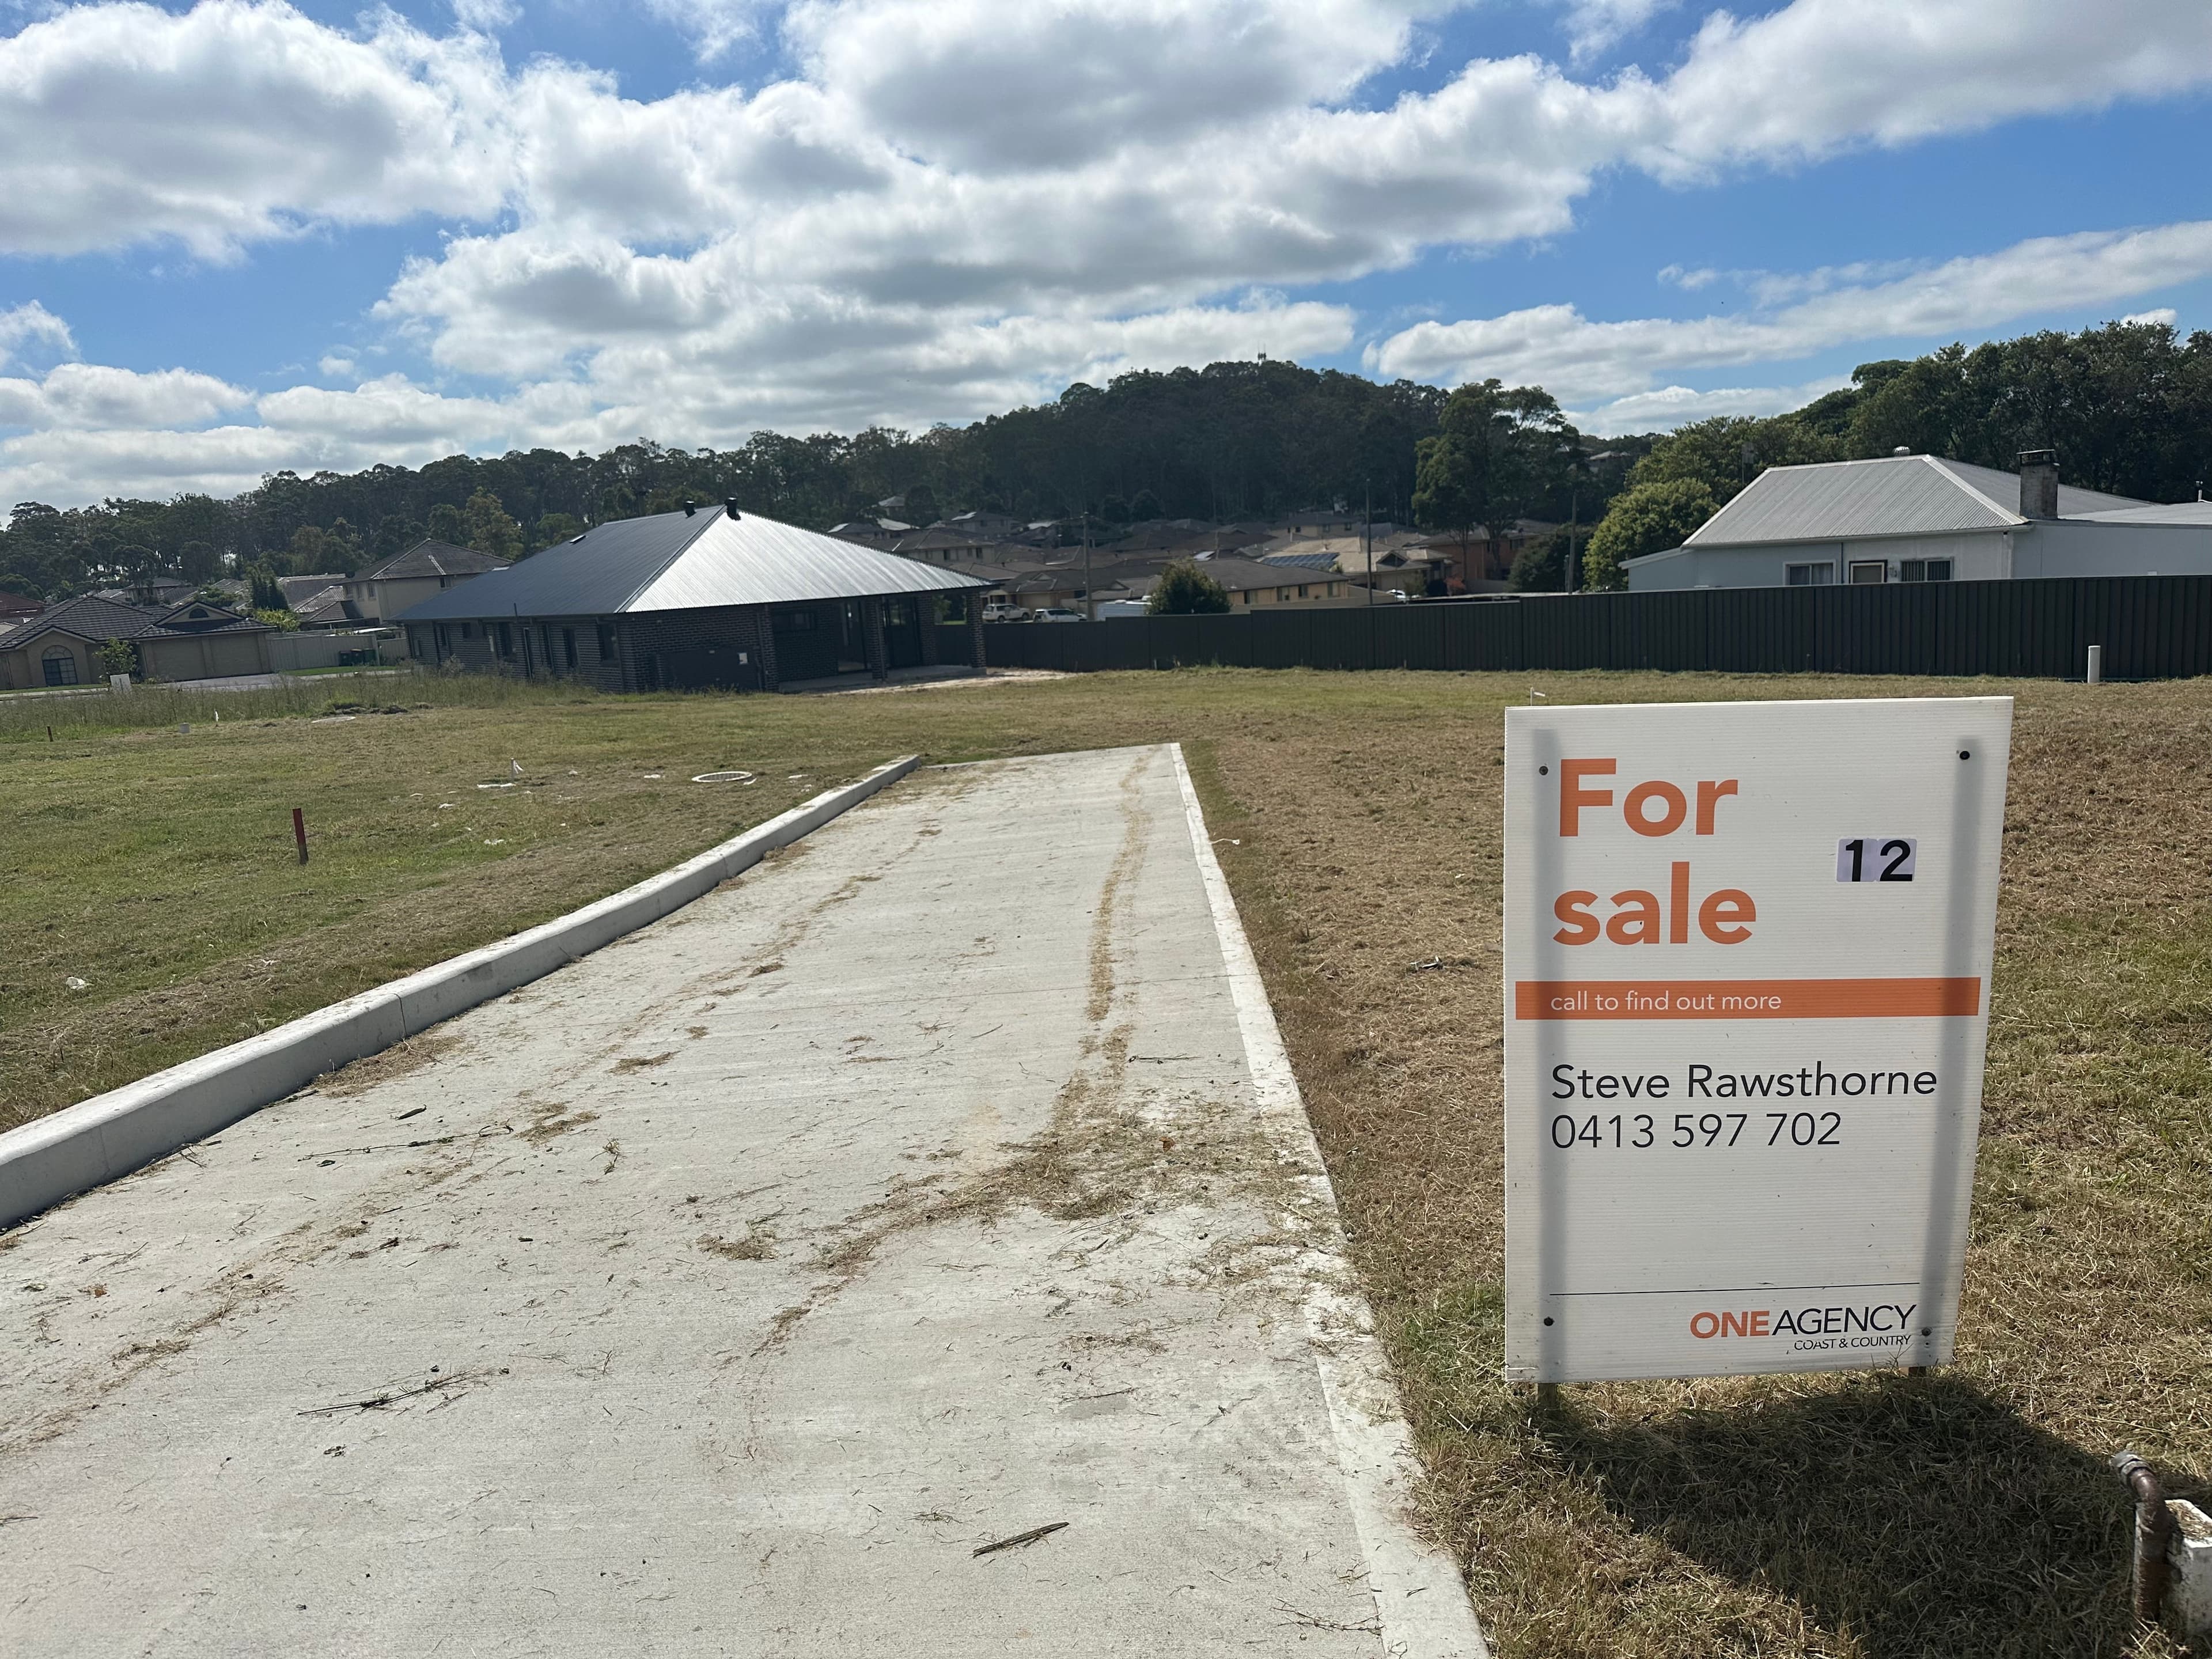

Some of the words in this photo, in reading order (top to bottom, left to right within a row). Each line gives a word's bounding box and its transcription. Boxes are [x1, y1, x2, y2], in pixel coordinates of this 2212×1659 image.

[1559, 758, 1738, 837] For
[1845, 839, 1913, 882] 12
[1553, 861, 1756, 945] sale
[1551, 990, 1588, 1011] call
[1594, 994, 1619, 1011] to
[1625, 990, 1669, 1010] find
[1676, 994, 1715, 1010] out
[1721, 995, 1782, 1010] more
[1551, 1064, 1670, 1099] Steve
[1688, 1060, 1937, 1099] Rawsthorne
[1551, 1114, 1654, 1149] 0413
[1671, 1113, 1747, 1147] 597
[1766, 1112, 1841, 1146] 702
[1794, 1338, 1837, 1351] COAST
[1838, 1338, 1848, 1349] &
[1850, 1335, 1911, 1349] COUNTRY
